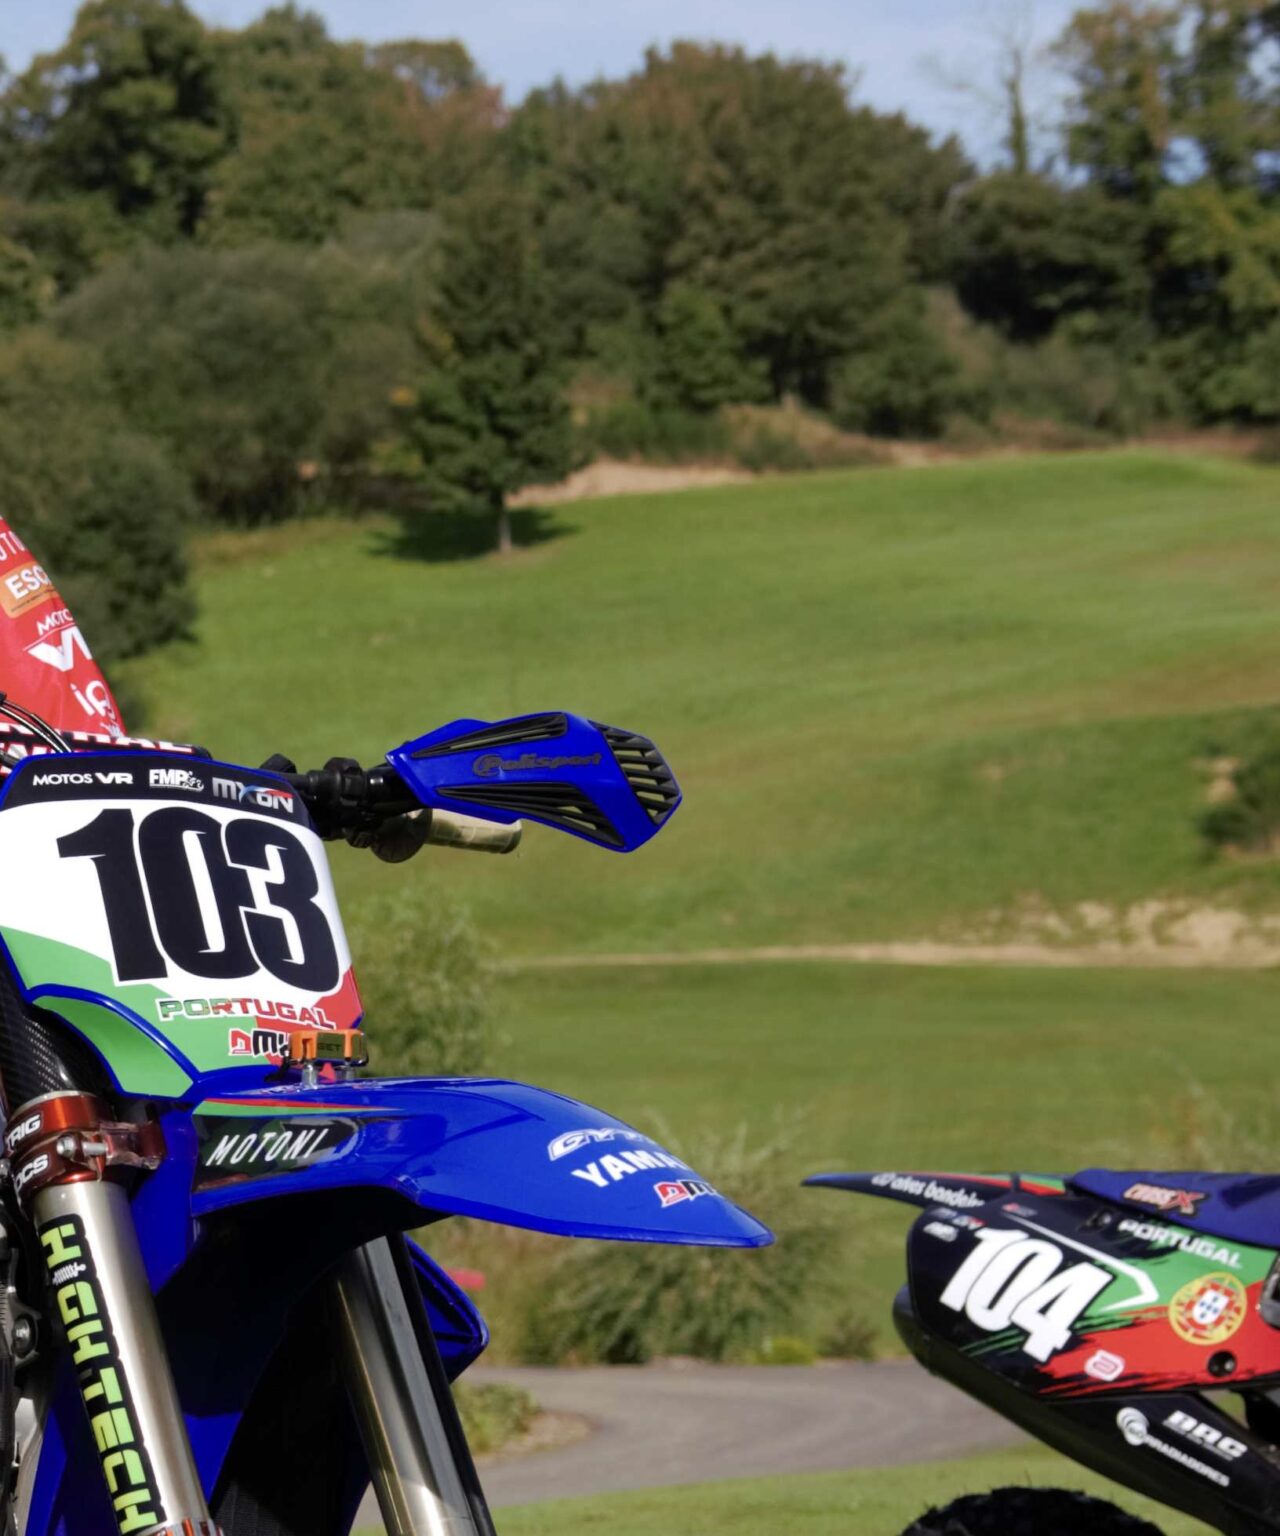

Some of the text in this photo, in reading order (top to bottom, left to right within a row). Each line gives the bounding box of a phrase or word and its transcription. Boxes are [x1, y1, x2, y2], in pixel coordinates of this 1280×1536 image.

[32, 772, 133, 786] MOTOS VR
[149, 769, 189, 787] FMP
[472, 753, 602, 778] Polisport
[56, 807, 340, 993] 103
[157, 998, 336, 1031] PORTUGAL
[205, 1128, 329, 1166] MOTONI
[1118, 1218, 1242, 1270] PORTUGAL
[939, 1227, 1114, 1363] 104
